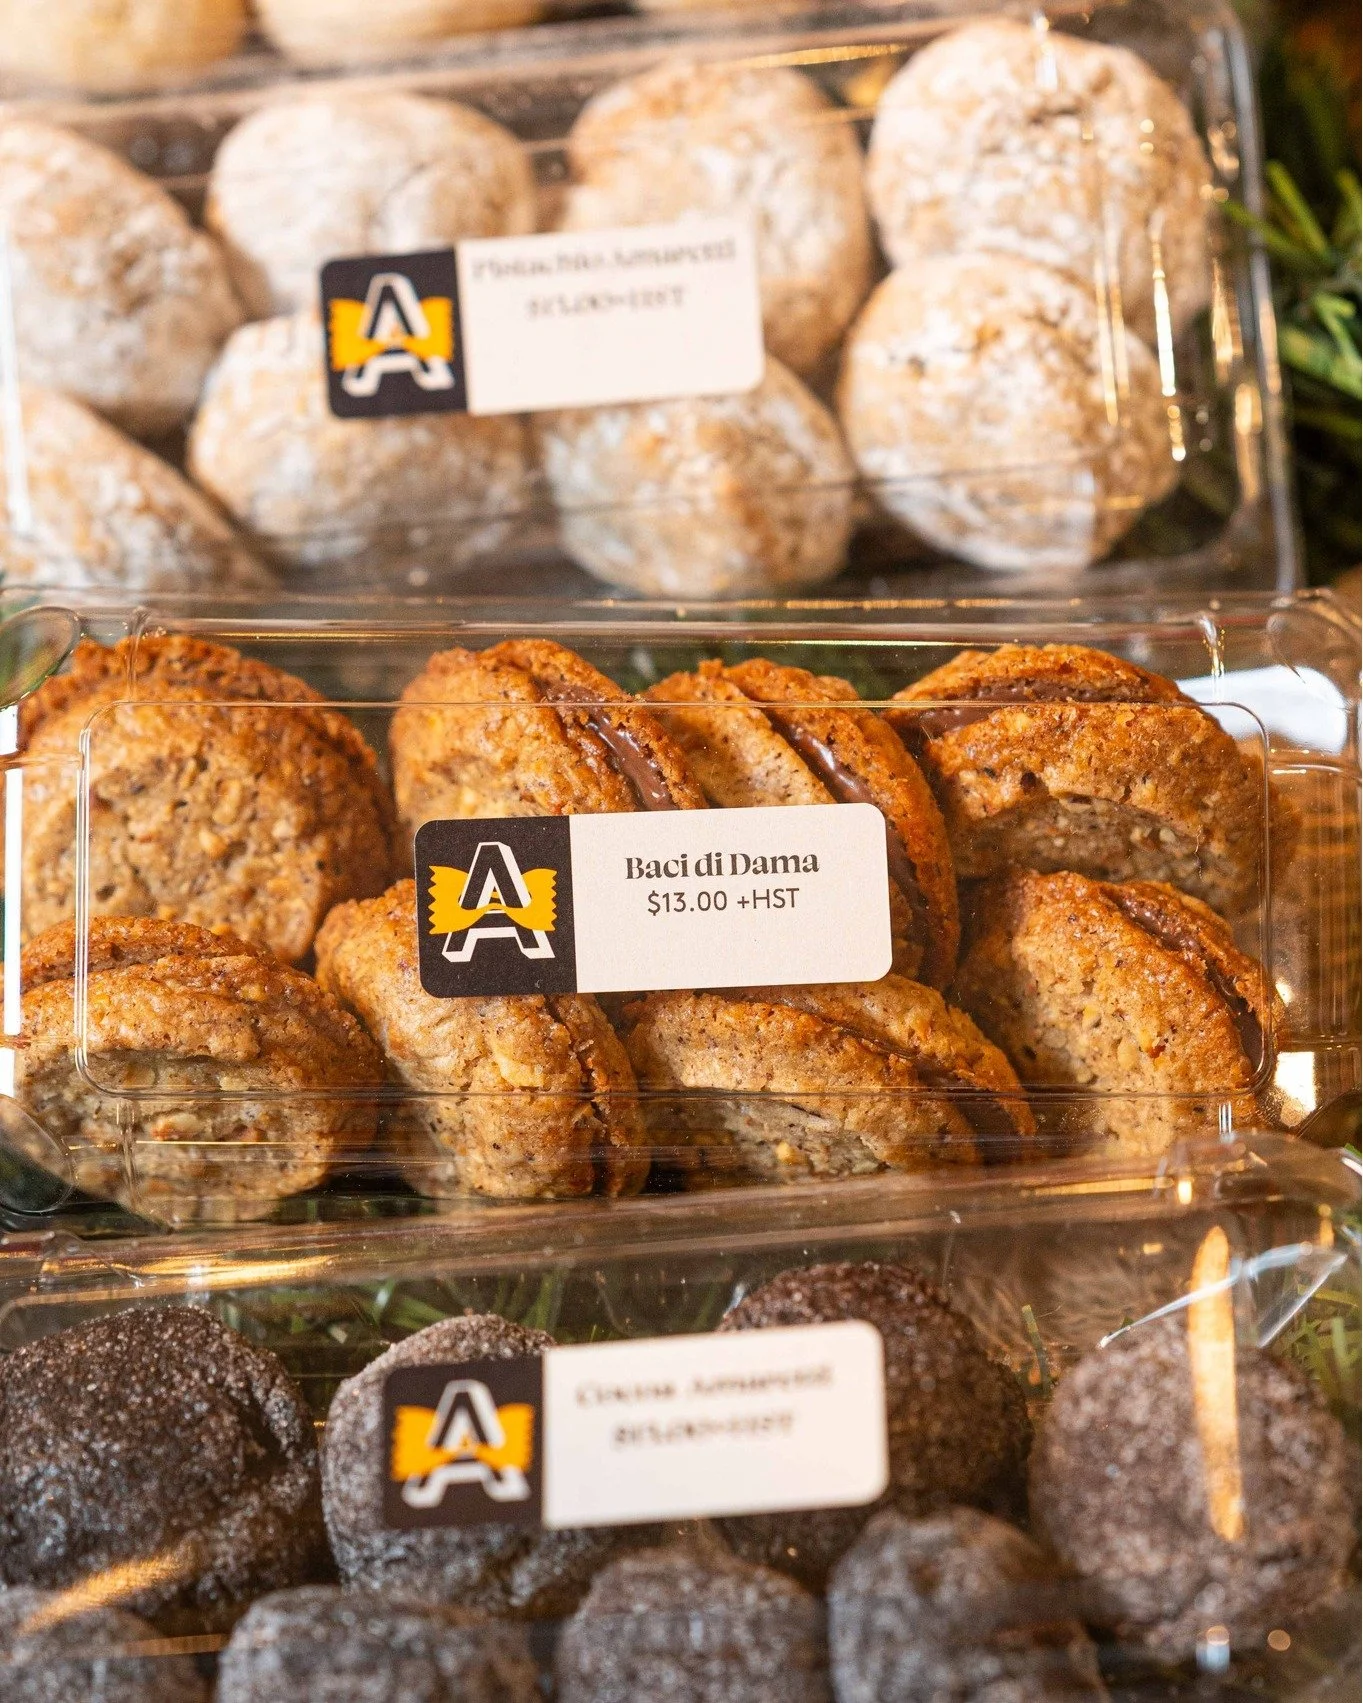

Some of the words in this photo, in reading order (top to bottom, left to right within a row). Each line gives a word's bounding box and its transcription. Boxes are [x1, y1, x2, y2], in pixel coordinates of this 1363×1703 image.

[625, 853, 690, 880] Baci
[694, 851, 724, 877] di
[729, 851, 820, 876] Dama
[647, 889, 728, 917] $13.00
[736, 887, 800, 910] +HST
